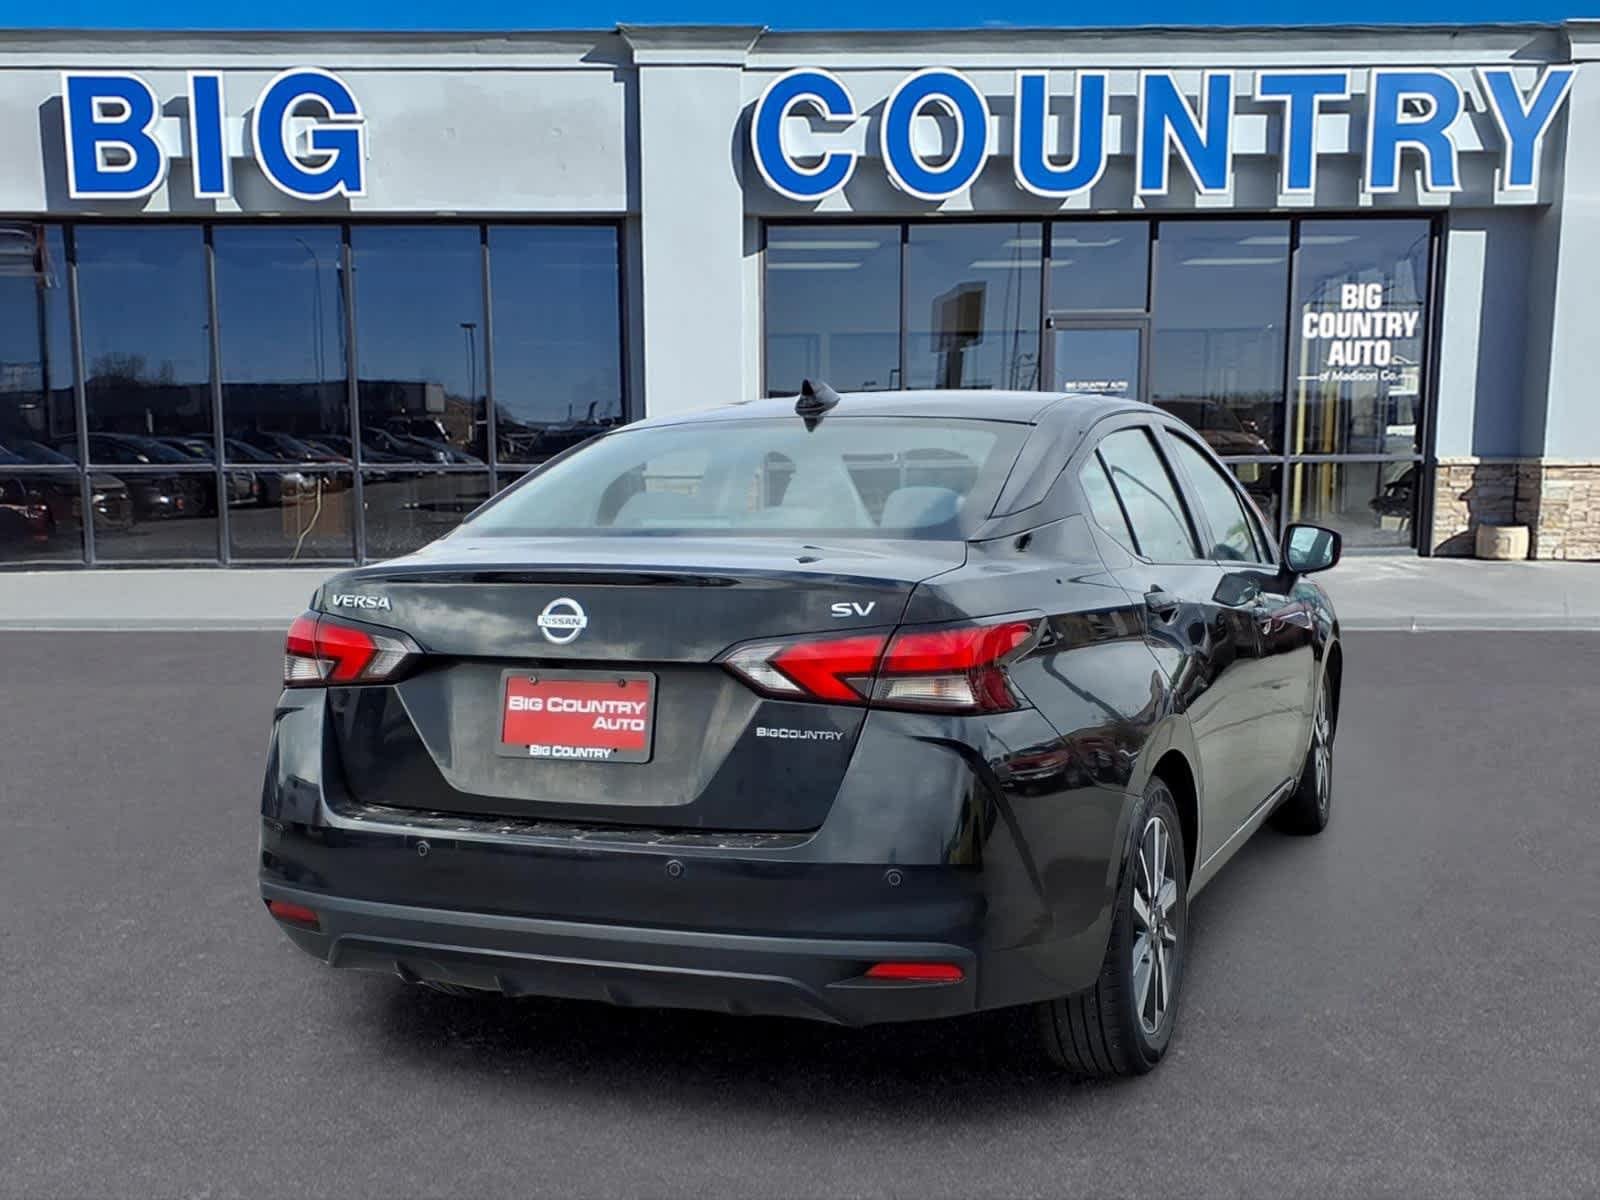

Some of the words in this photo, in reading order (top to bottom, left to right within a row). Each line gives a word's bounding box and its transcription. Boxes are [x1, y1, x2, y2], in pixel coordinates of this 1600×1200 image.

[61, 67, 368, 200] BIG
[750, 66, 1577, 203] COUNTRY
[1341, 283, 1382, 310] BIG
[1303, 311, 1419, 338] COUNTRY
[1328, 340, 1391, 366] AUTO
[332, 594, 391, 611] VERSA
[831, 601, 876, 617] SV
[541, 617, 580, 625] NISSAN
[508, 696, 543, 711] BIG
[547, 697, 646, 715] COUNTRY
[592, 716, 645, 731] AUTO
[529, 744, 550, 756] BIG
[552, 745, 612, 759] COUNTRY
